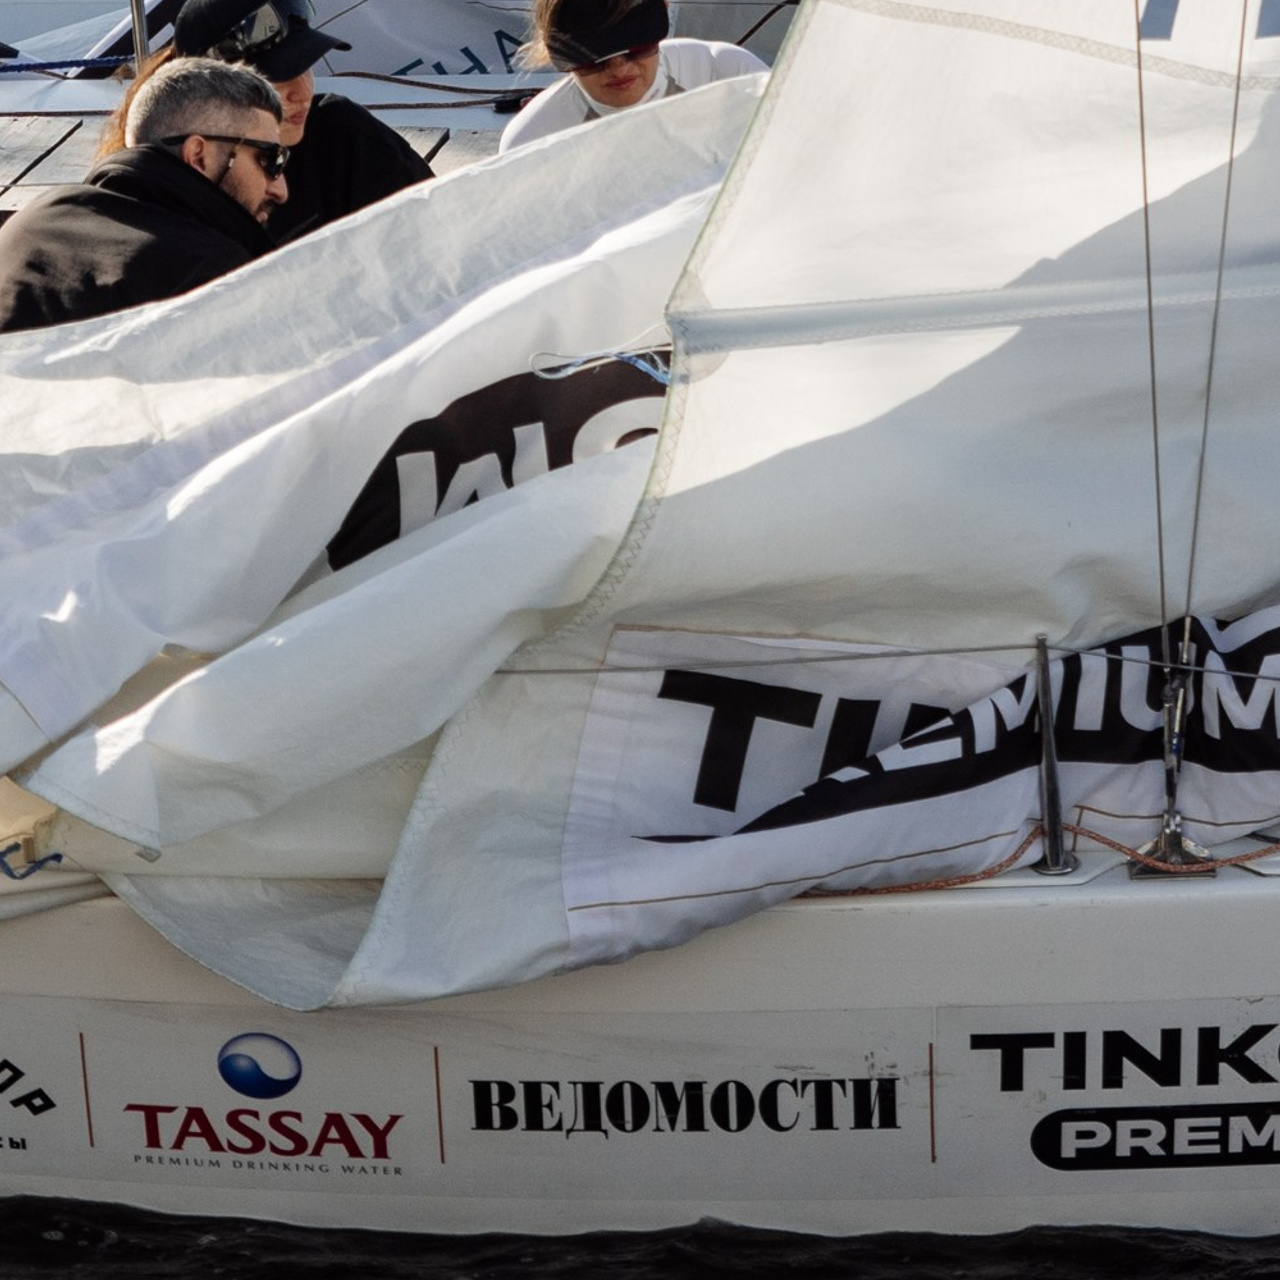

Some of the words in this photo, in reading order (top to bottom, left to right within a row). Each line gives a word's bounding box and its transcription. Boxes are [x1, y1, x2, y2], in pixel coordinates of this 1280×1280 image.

[123, 1103, 405, 1160] TASSAY
[468, 1077, 902, 1140] ВЕДОМОСТИ
[133, 1154, 222, 1168] PREMIUM
[232, 1159, 330, 1174] DRINKING
[341, 1164, 404, 1176] WATER
